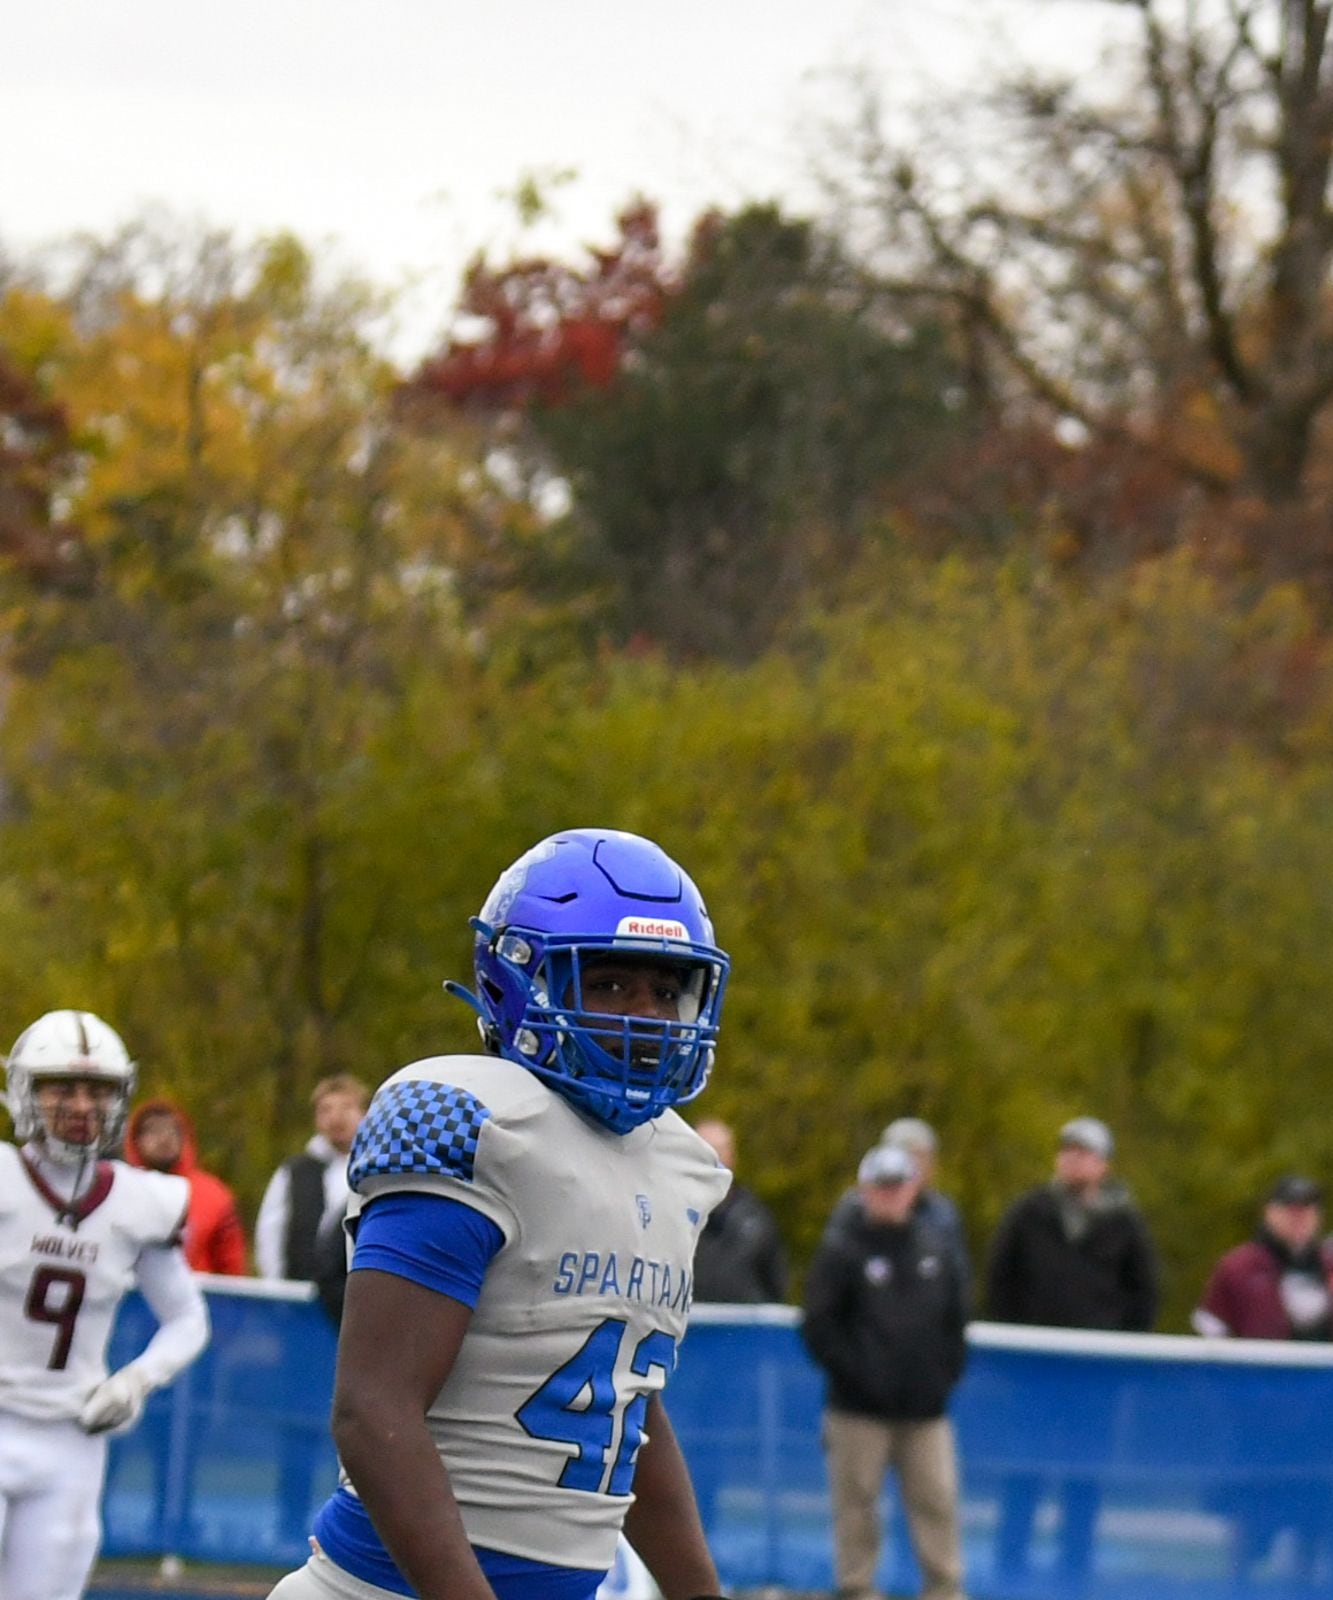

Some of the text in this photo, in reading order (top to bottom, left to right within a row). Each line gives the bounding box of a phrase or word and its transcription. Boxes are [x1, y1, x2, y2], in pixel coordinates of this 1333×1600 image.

[628, 921, 683, 938] Riddell
[31, 1234, 99, 1264] WOLVES
[24, 1263, 87, 1371] 9
[513, 1316, 677, 1497] 42
